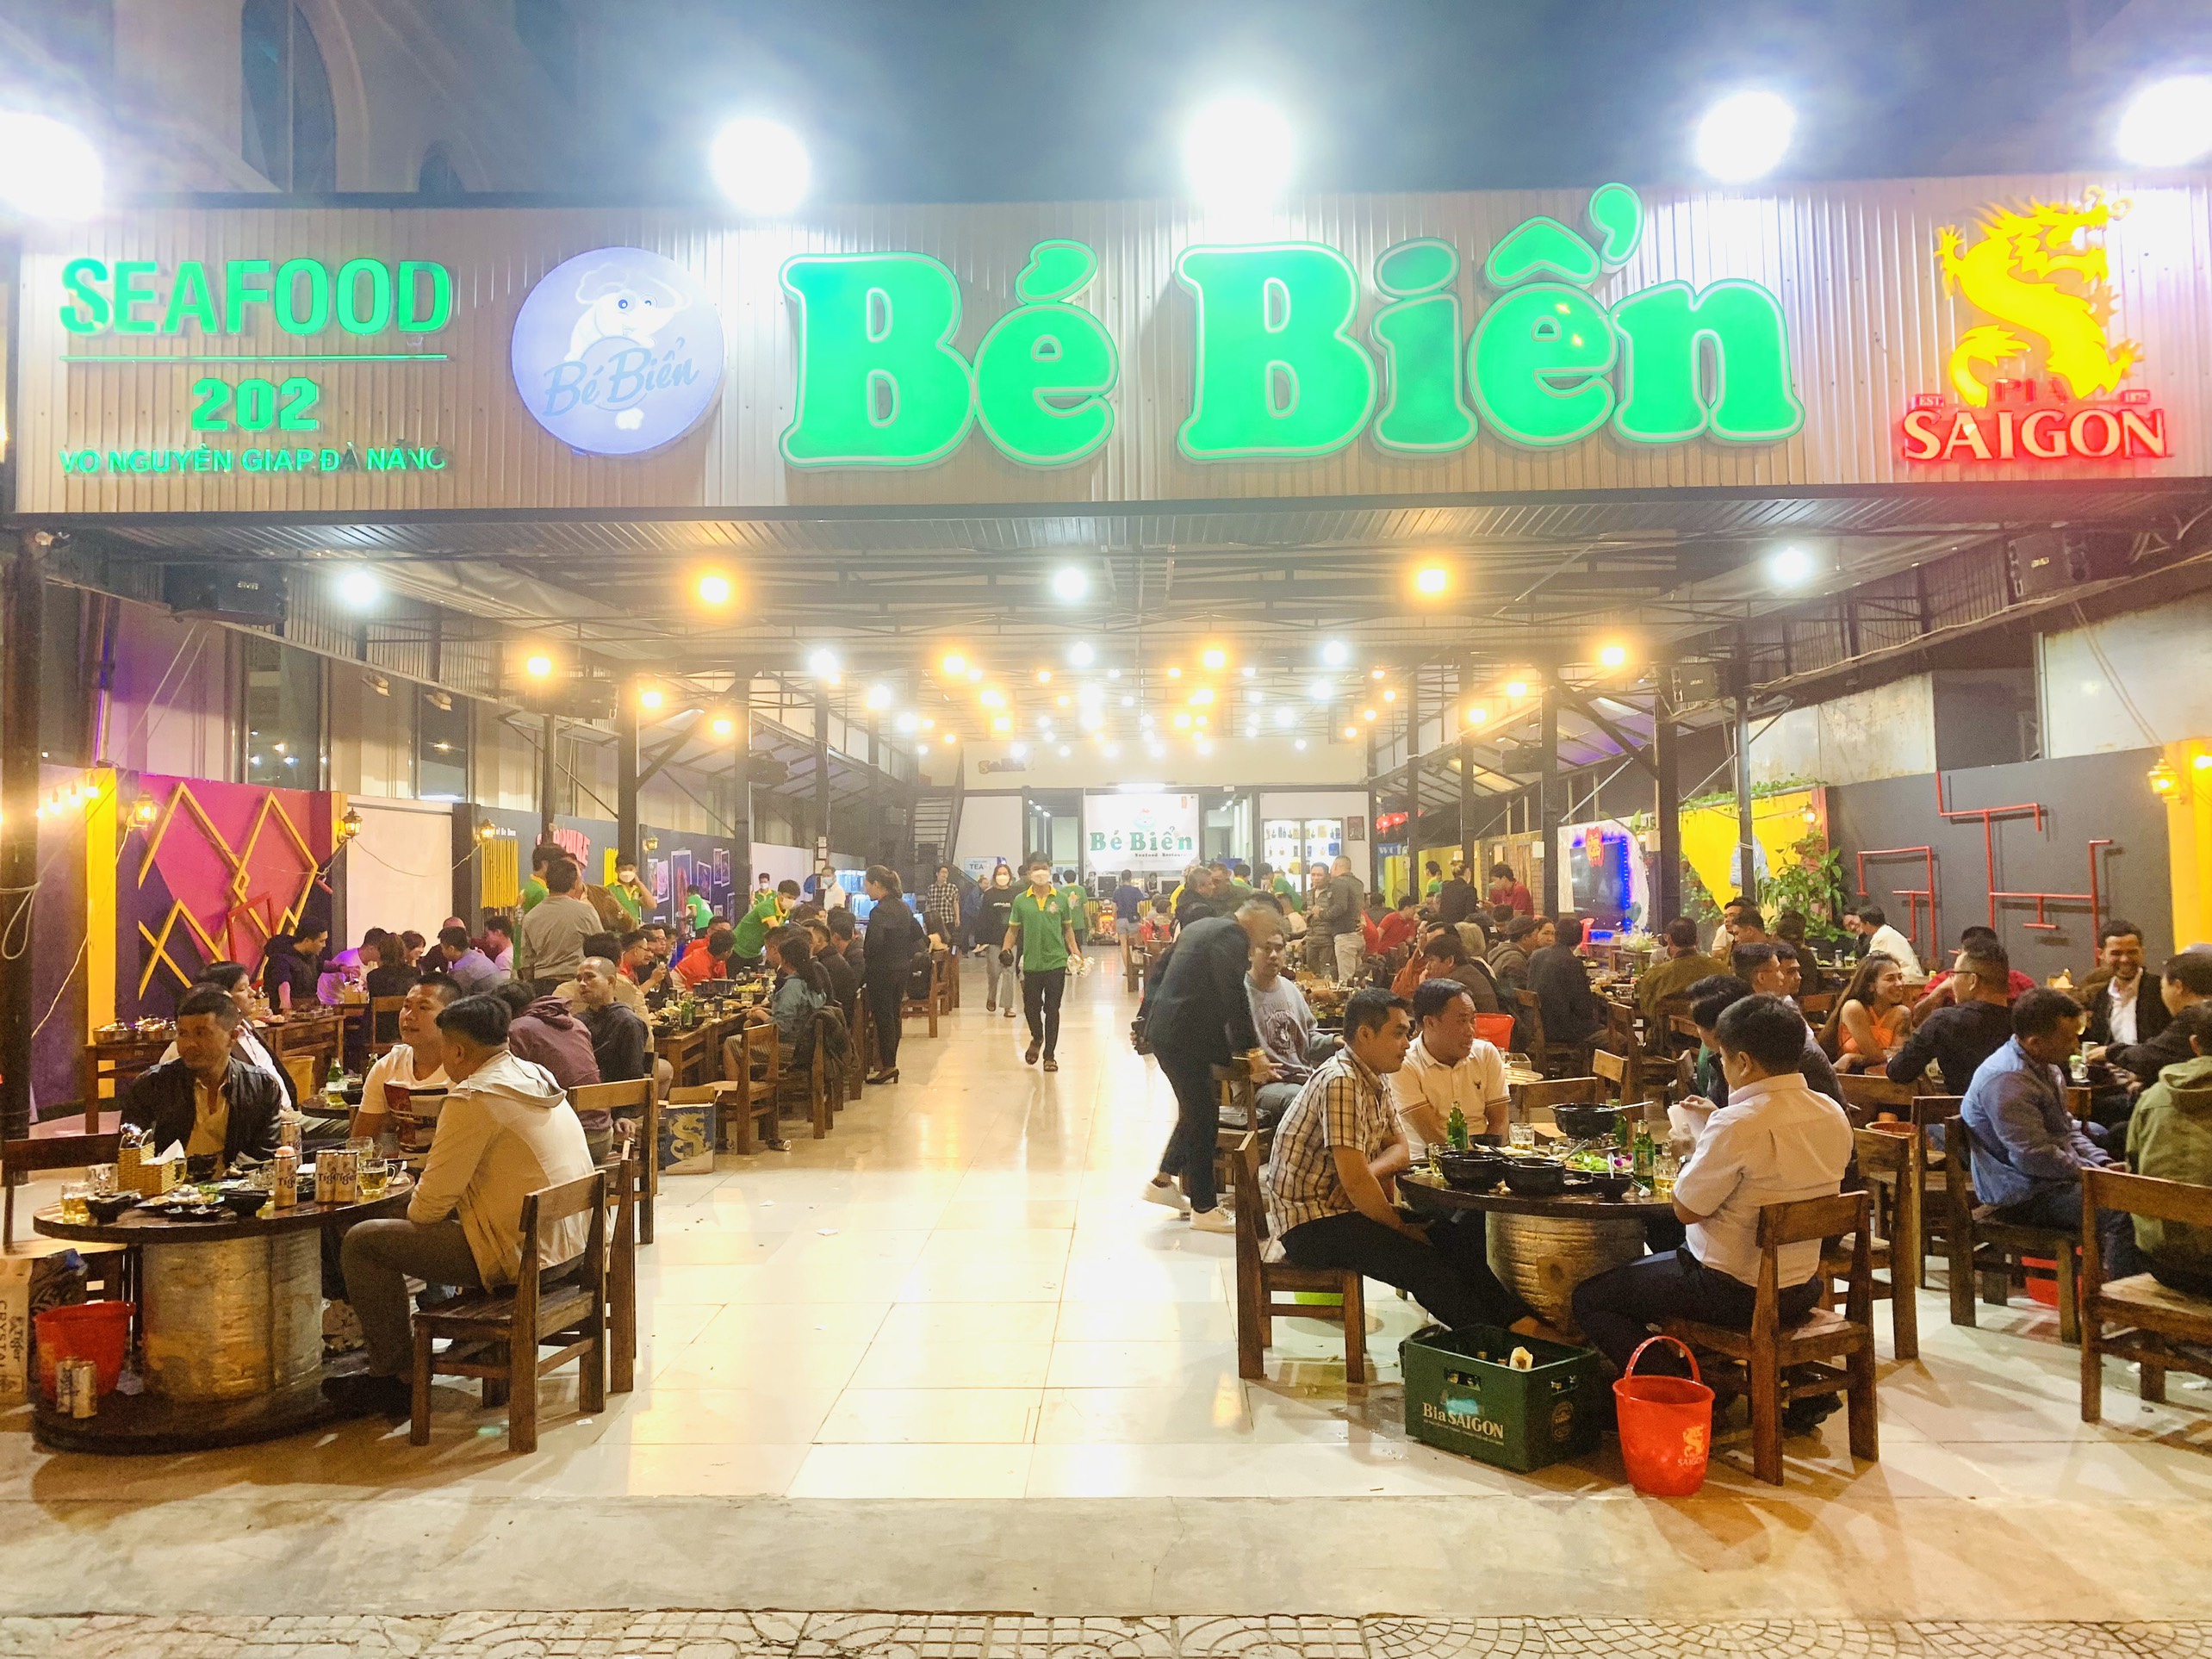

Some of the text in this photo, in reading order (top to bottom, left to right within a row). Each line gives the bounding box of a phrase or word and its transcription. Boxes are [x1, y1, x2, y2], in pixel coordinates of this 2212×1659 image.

[59, 258, 453, 335] SEAFOOD
[541, 336, 699, 417] Bé Biển
[778, 237, 1120, 468] Bé
[191, 376, 320, 432] 202
[1904, 408, 2166, 460] SAIGON
[1090, 825, 1193, 851] Bé Biển
[1422, 1401, 1446, 1422] Bia
[1448, 1410, 1503, 1439] SAIGON
